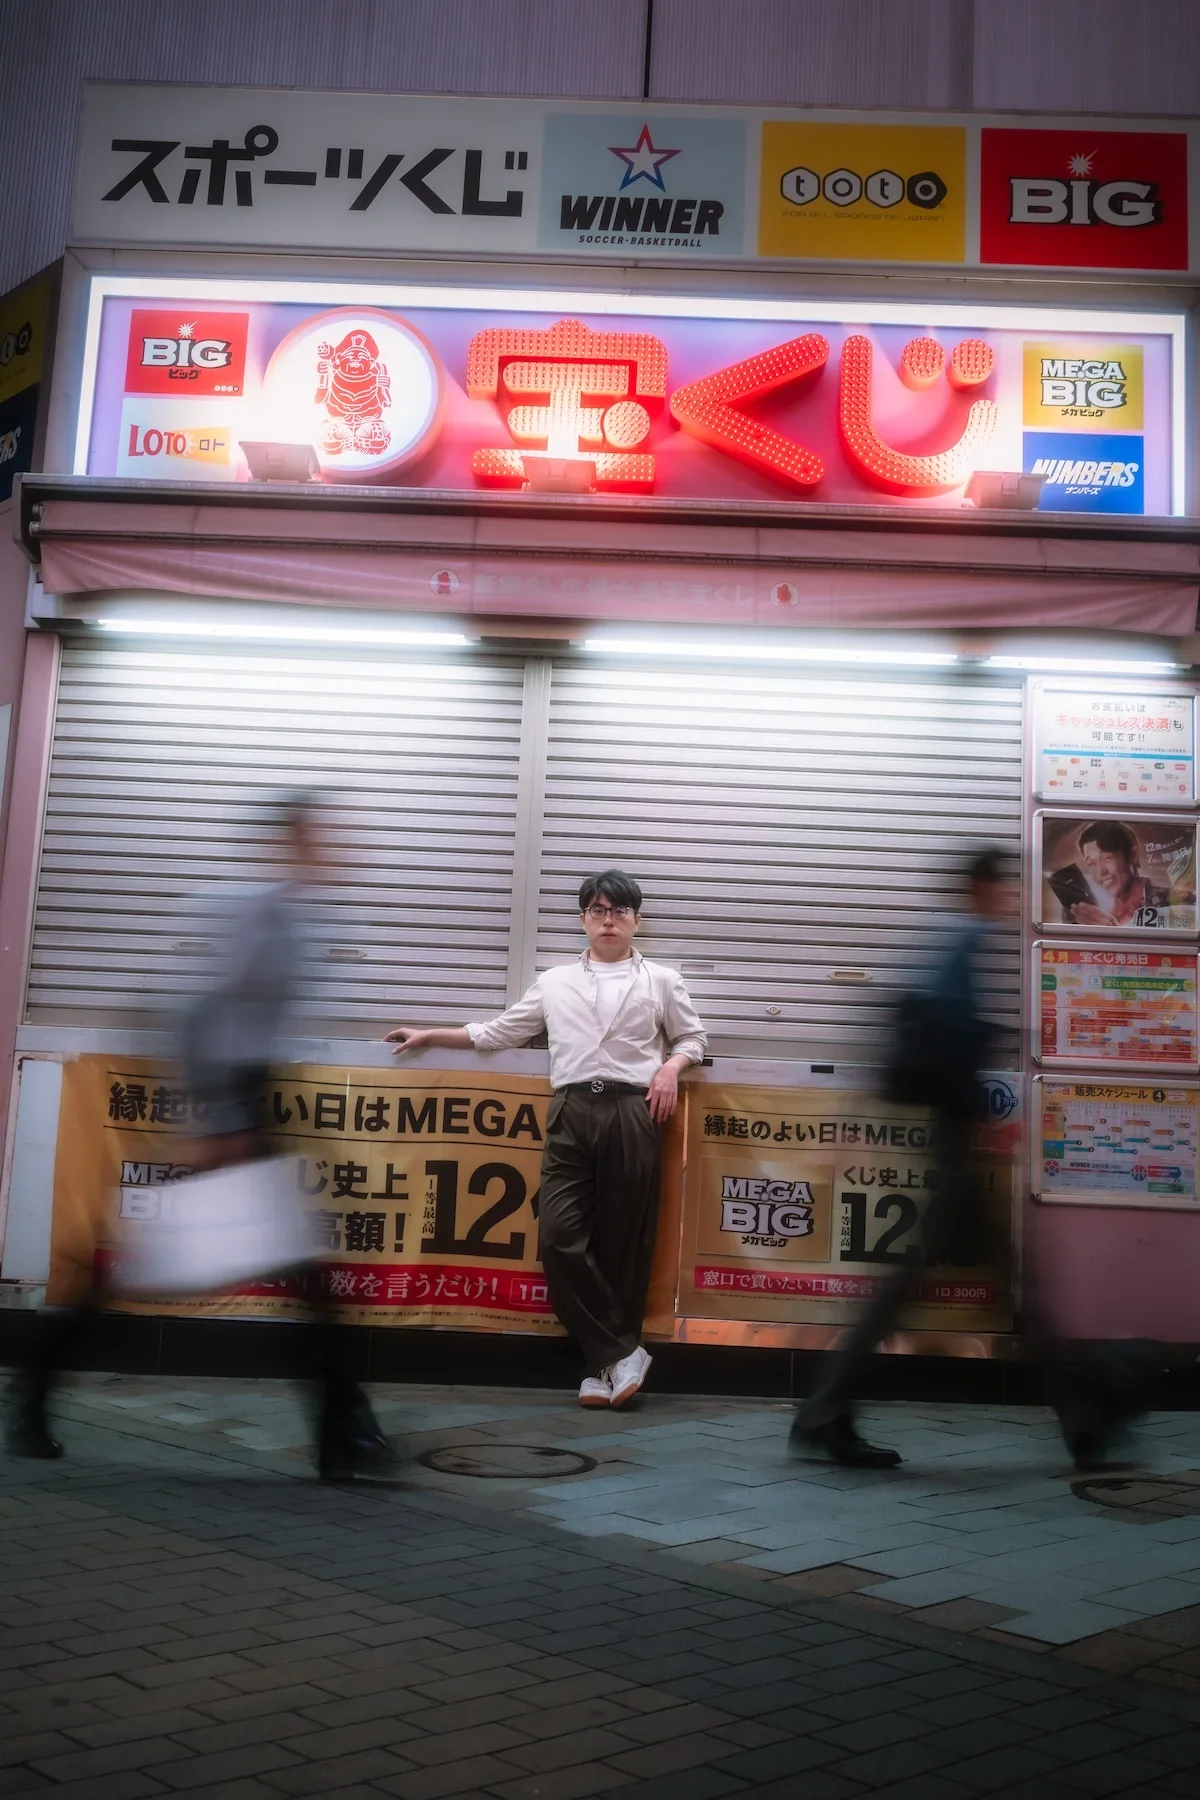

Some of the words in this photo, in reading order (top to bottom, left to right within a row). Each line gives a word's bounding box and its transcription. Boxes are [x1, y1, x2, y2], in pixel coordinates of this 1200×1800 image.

[101, 125, 528, 217] スポーツくじ
[780, 166, 948, 209] toto
[560, 195, 724, 235] WINNER
[1008, 177, 1161, 228] BIG
[141, 337, 232, 369] BIG
[168, 368, 201, 380] ビッグ
[1041, 359, 1127, 380] MEGA
[1041, 379, 1127, 408] BIG
[466, 318, 1000, 499] 宝くじ
[1061, 408, 1105, 417] メガビッグ
[128, 424, 186, 457] LOTO
[199, 438, 225, 452] ロト
[1031, 458, 1139, 487] NUMBERS
[1065, 486, 1101, 495] ナンバーズ
[1091, 702, 1146, 713] お支払いは
[1055, 714, 1184, 732] キャッシュレス決済も
[1043, 951, 1069, 963] 4月
[1079, 952, 1149, 965] 宝くじ発売日
[1074, 1085, 1148, 1100] 販売スケジュール
[106, 1082, 543, 1142] 縁起い日はMEGA
[704, 1115, 935, 1149] 縁起のよい日はMEG
[121, 1160, 193, 1186] MEG
[298, 1159, 410, 1201] じ史上
[722, 1175, 815, 1204] MEGA
[422, 1179, 437, 1235] 1等最高
[720, 1200, 814, 1237] BIG
[304, 1209, 406, 1253] 高額!
[741, 1236, 789, 1248] メガビッグ
[953, 1288, 987, 1298] 300円
